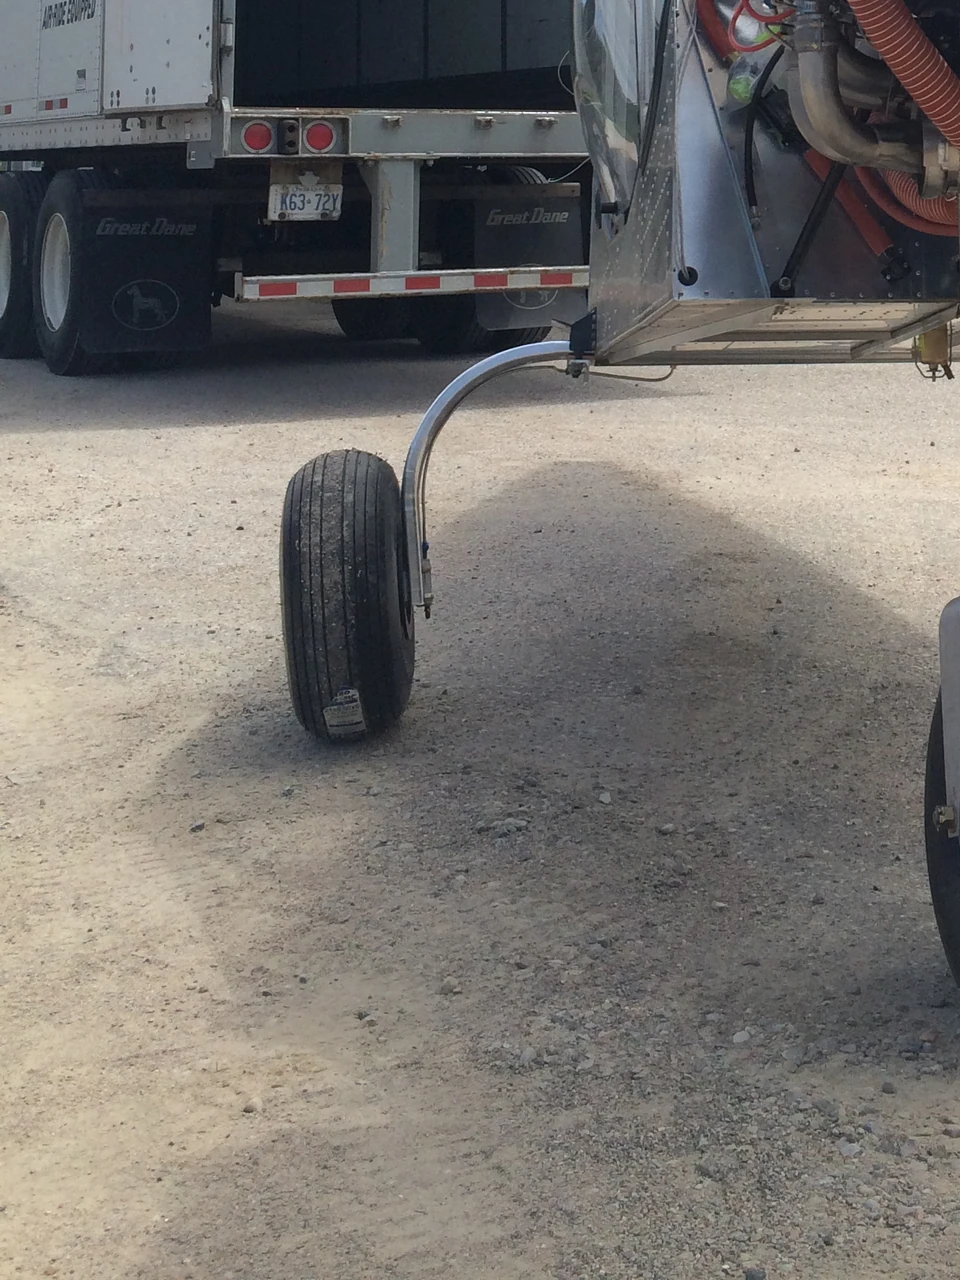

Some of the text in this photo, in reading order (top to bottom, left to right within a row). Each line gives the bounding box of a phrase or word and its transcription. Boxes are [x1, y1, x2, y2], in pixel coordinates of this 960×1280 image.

[486, 207, 569, 225] Great Dane
[96, 217, 196, 236] Great Dane
